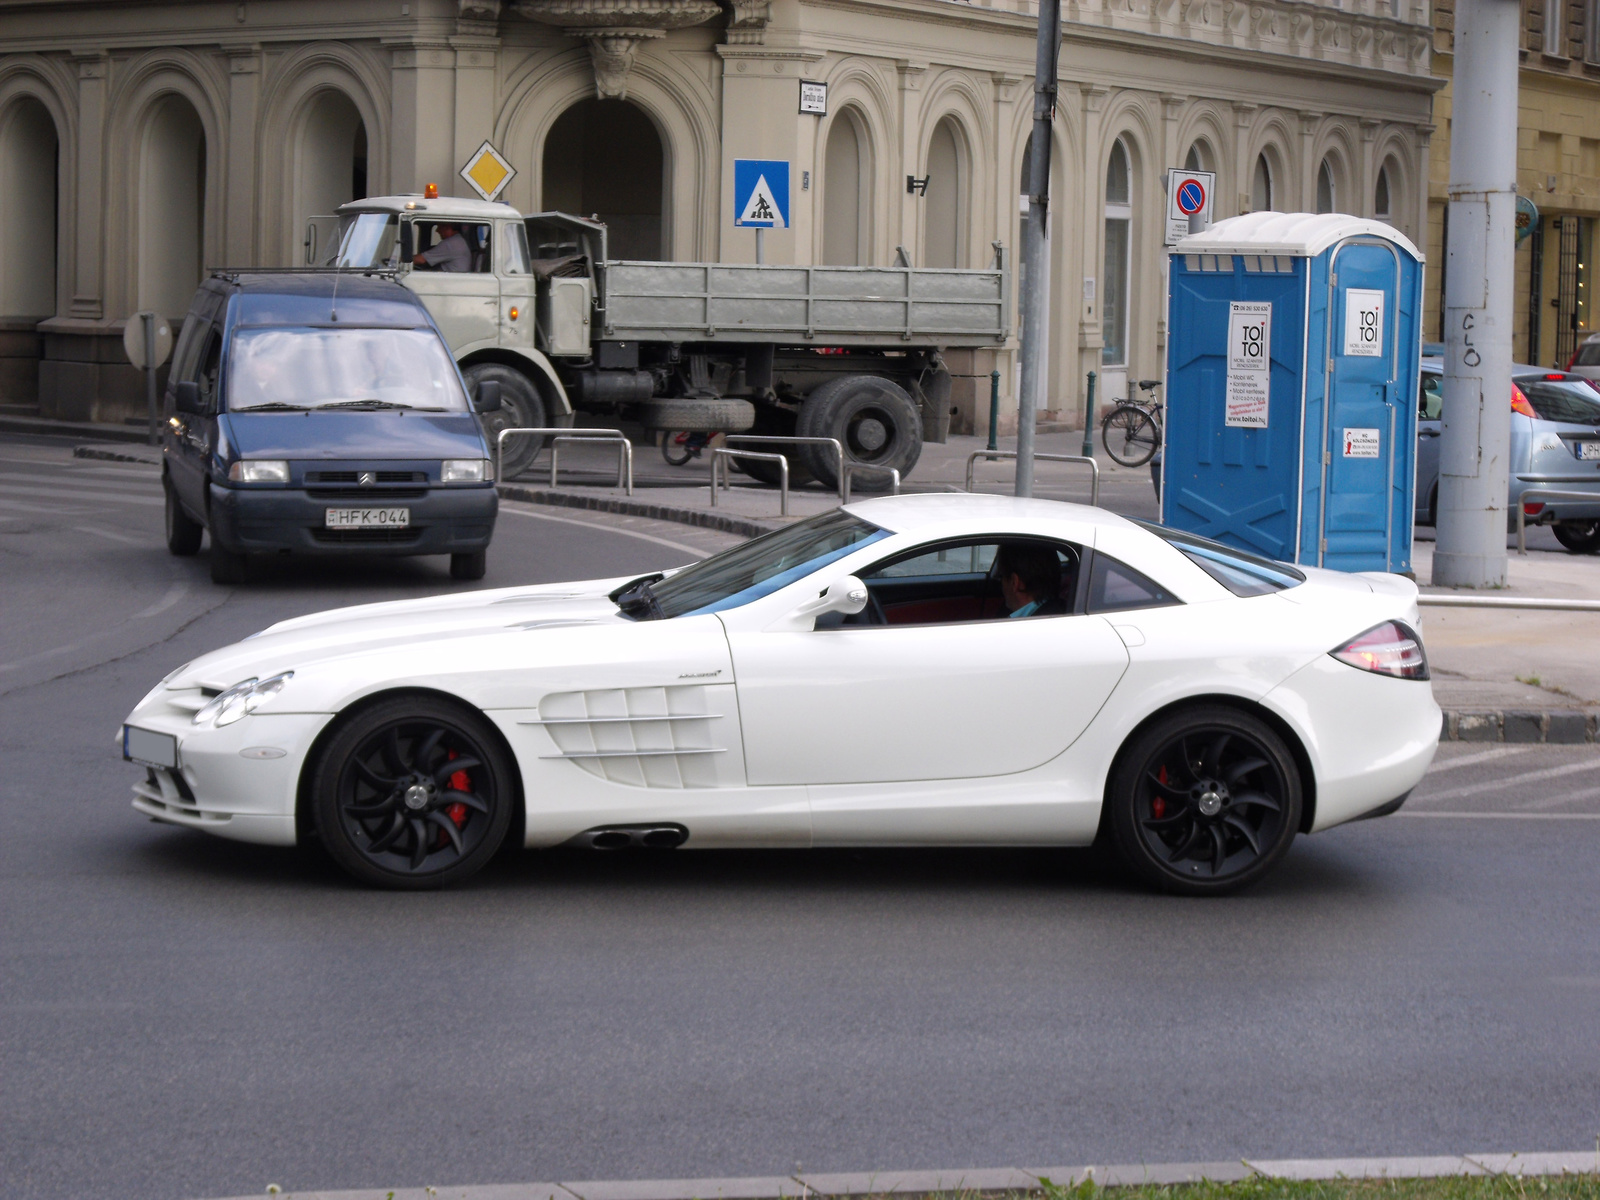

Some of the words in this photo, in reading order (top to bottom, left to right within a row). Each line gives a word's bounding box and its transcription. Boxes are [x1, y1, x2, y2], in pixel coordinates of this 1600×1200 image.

[1360, 327, 1377, 342] TOI
[1242, 342, 1263, 357] TOI
[339, 510, 406, 524] HFK-044
